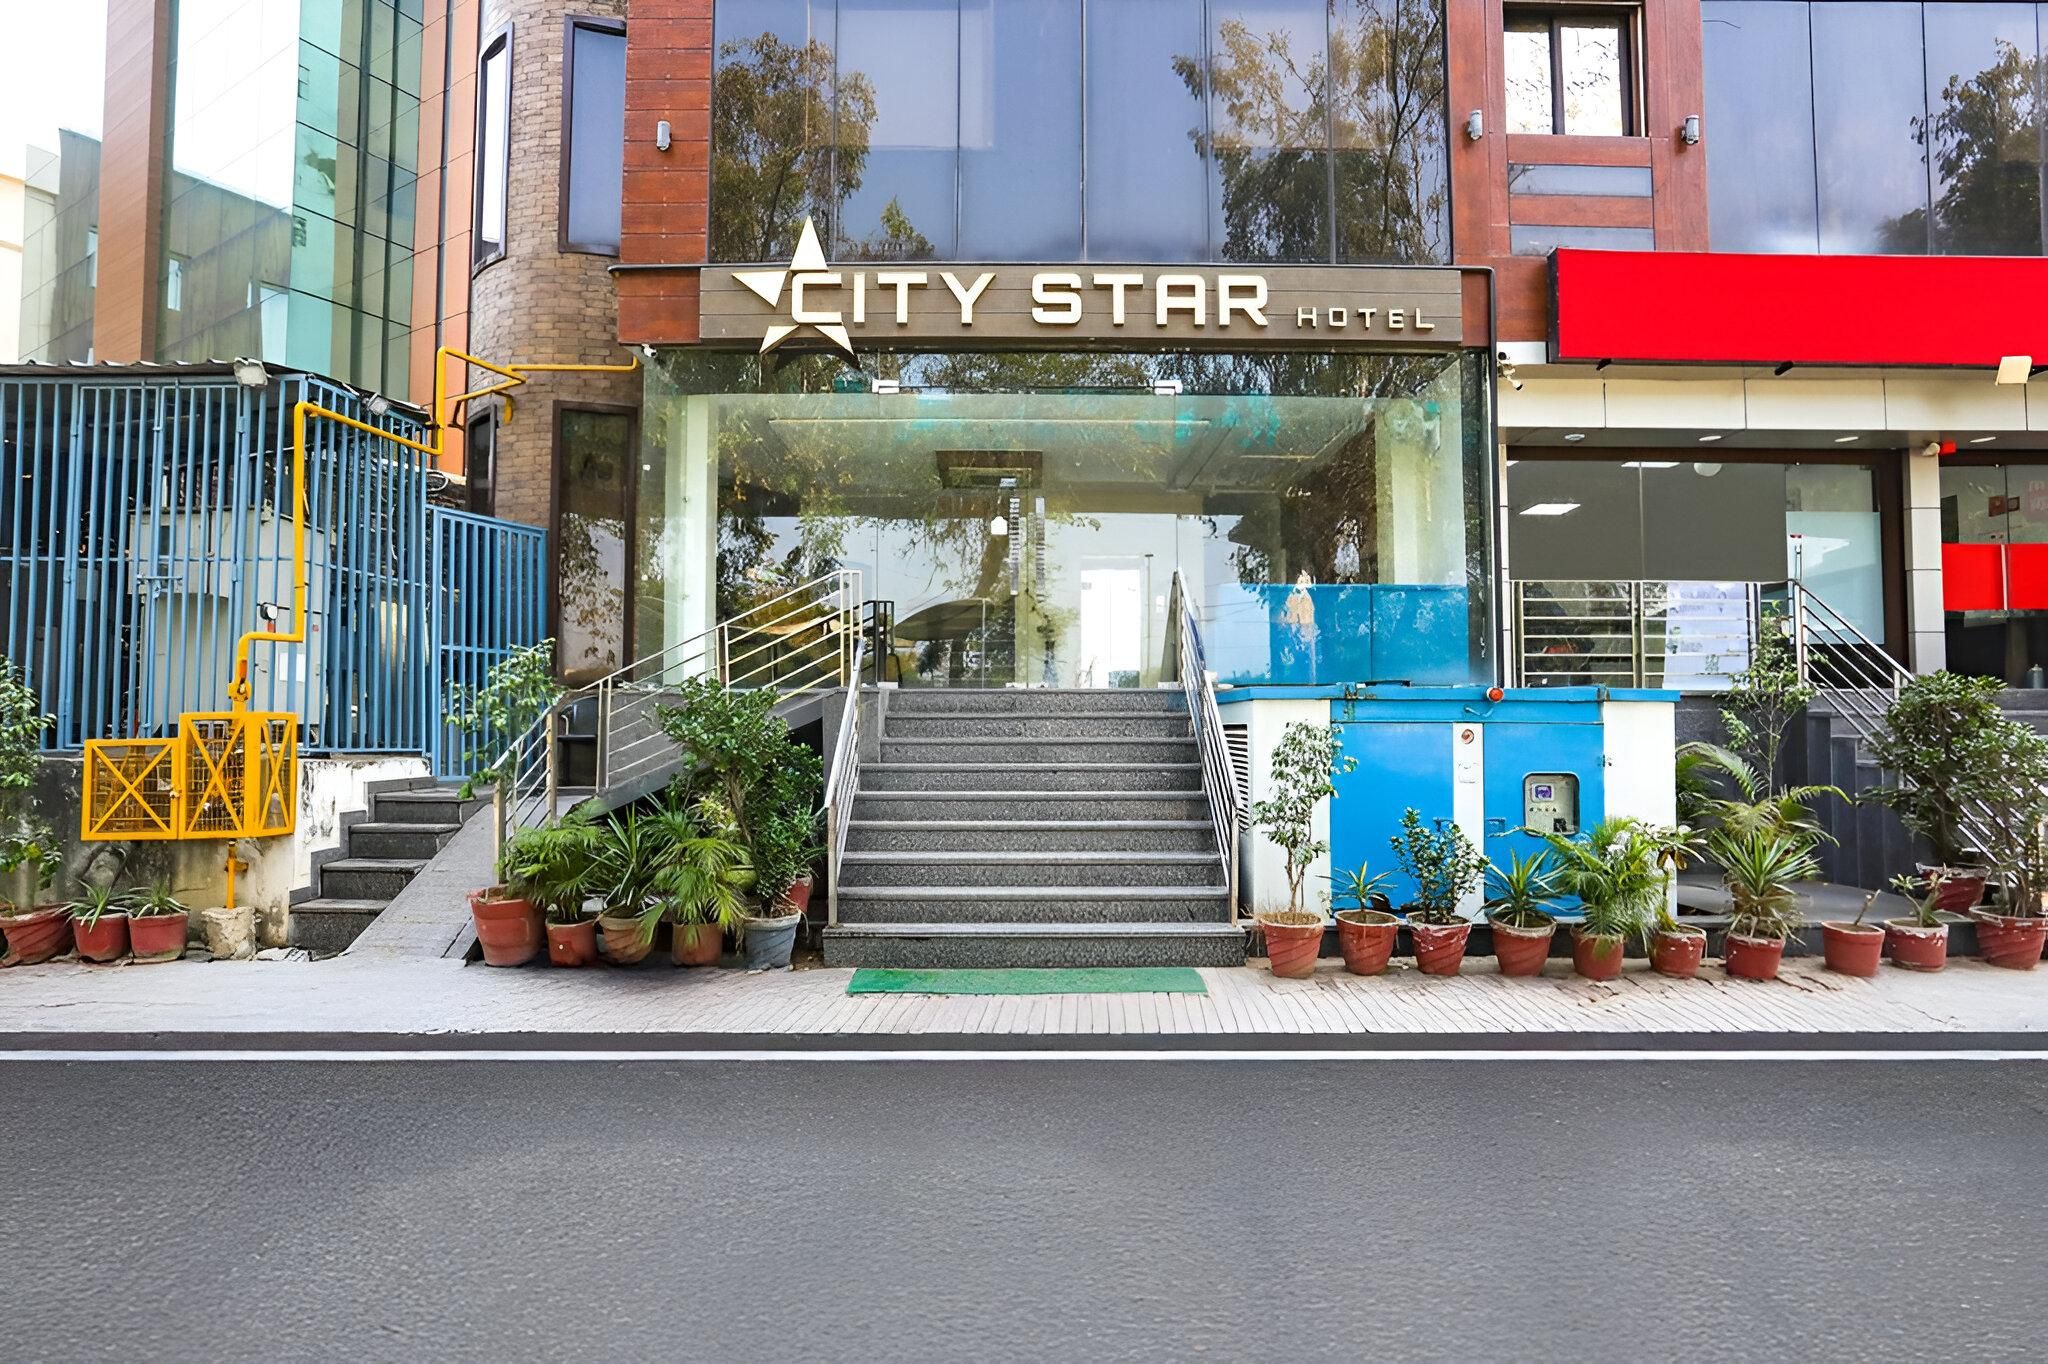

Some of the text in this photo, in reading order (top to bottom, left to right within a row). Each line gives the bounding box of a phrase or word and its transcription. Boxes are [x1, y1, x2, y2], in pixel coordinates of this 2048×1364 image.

[791, 272, 1436, 331] CITY STAR HOTEL
